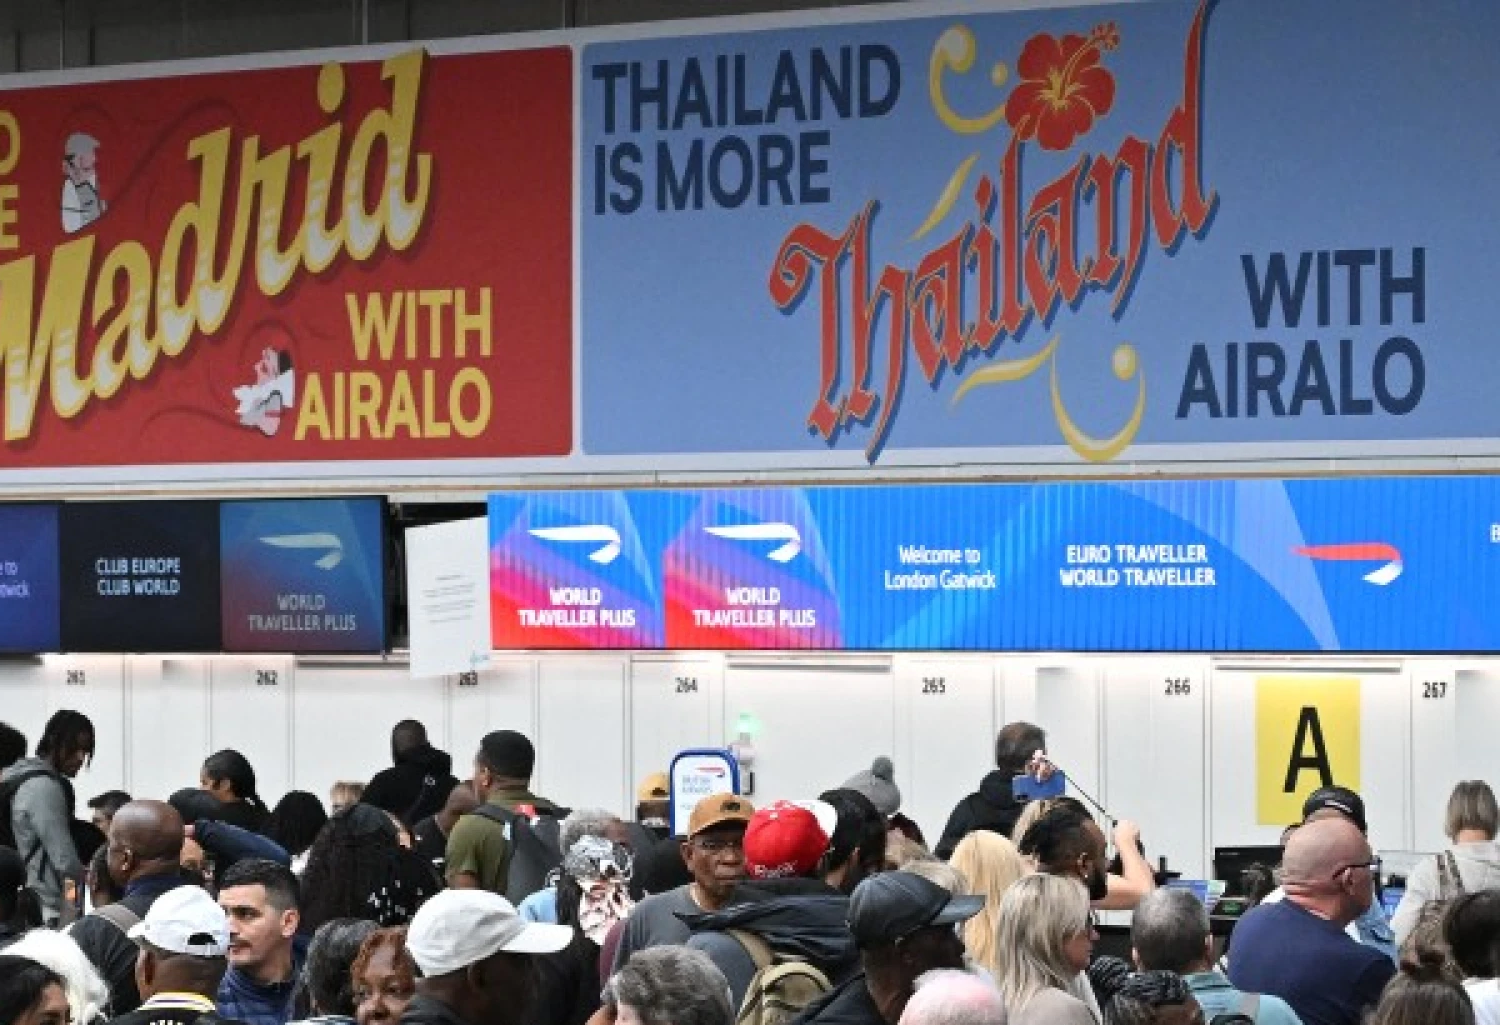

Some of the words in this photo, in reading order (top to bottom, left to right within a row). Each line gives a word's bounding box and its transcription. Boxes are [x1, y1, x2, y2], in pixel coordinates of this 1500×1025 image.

[591, 43, 900, 135] THAILAND
[594, 142, 642, 215] IS
[656, 131, 831, 209] MORE
[1241, 247, 1426, 329] WITH
[345, 287, 493, 361] WITH
[1175, 337, 1426, 420] AIRALO
[294, 367, 493, 441] AIRALO
[899, 545, 959, 565] Welcome
[962, 547, 980, 564] to
[1067, 545, 1111, 563] EURO
[1116, 544, 1207, 563] TRAVELLER
[4, 560, 18, 576] to
[96, 557, 128, 575] CLUB
[132, 557, 181, 575] EUROPE
[885, 570, 935, 589] London
[940, 570, 996, 589] Gatwick
[1060, 568, 1118, 587] WORLD
[1123, 568, 1216, 586] TRAVELLER
[97, 579, 132, 595] CLUB
[134, 579, 180, 596] WORLD
[549, 588, 601, 605] WORLD
[725, 588, 781, 605] WORLD
[277, 594, 325, 611] WORLD
[247, 614, 321, 631] TRAVELLER
[325, 614, 356, 631] PLUS
[518, 610, 597, 627] TRAVELLER
[600, 609, 635, 626] PLUS
[693, 609, 776, 627] TRAVELLER
[779, 609, 816, 627] PLUS
[256, 670, 278, 686] 262
[675, 677, 698, 694] 264
[922, 678, 946, 694] 265
[1165, 679, 1191, 695] 266
[1423, 682, 1447, 698] 267
[1283, 706, 1334, 793] A
